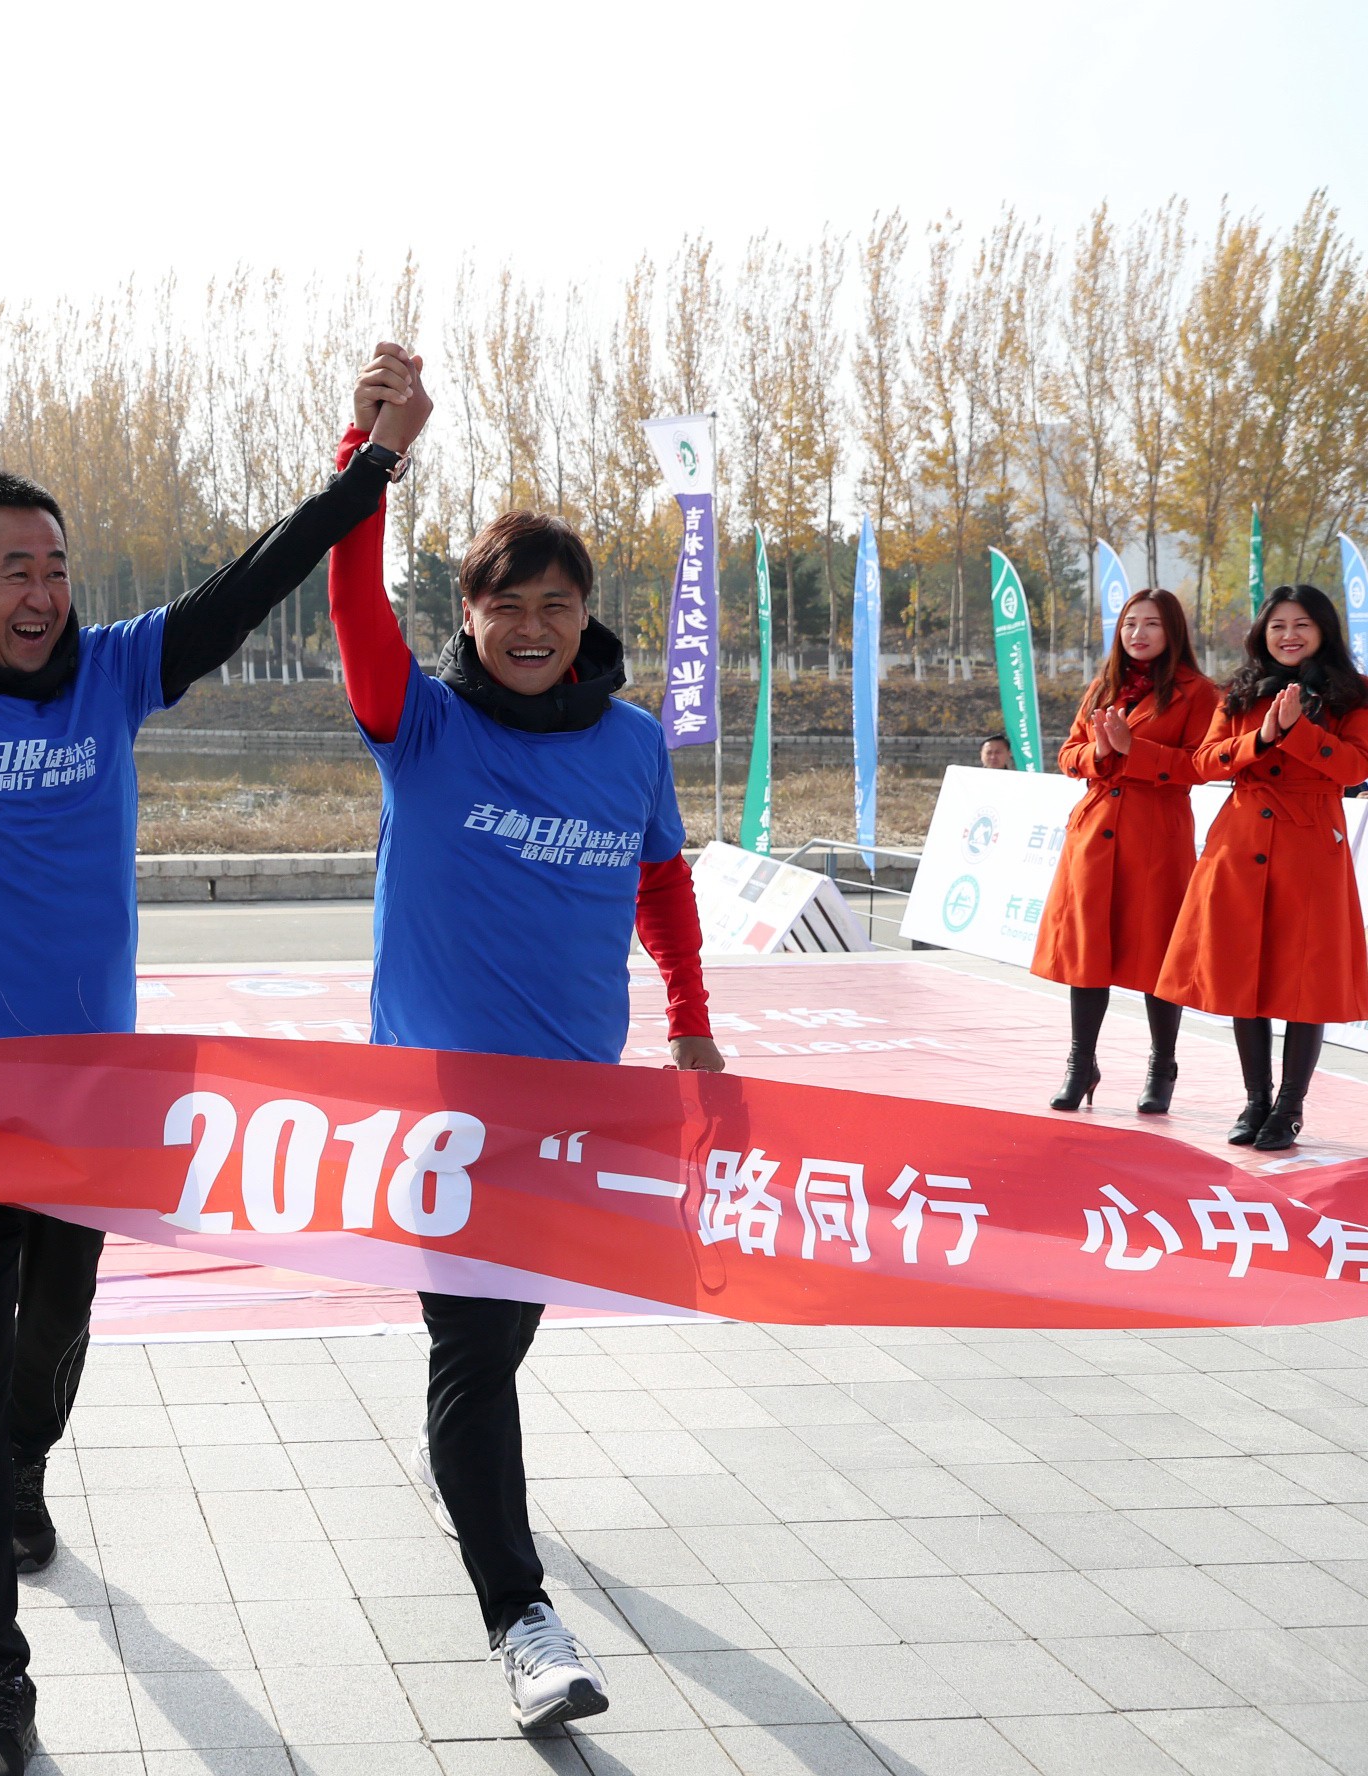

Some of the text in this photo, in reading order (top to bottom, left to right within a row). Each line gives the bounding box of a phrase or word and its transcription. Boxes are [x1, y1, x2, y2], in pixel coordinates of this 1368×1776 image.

[41, 758, 97, 788] 心中有你
[463, 803, 641, 851] 吉林日报徒步大会
[505, 843, 635, 868] 一路同行 心中有你
[158, 1091, 487, 1237] 2018
